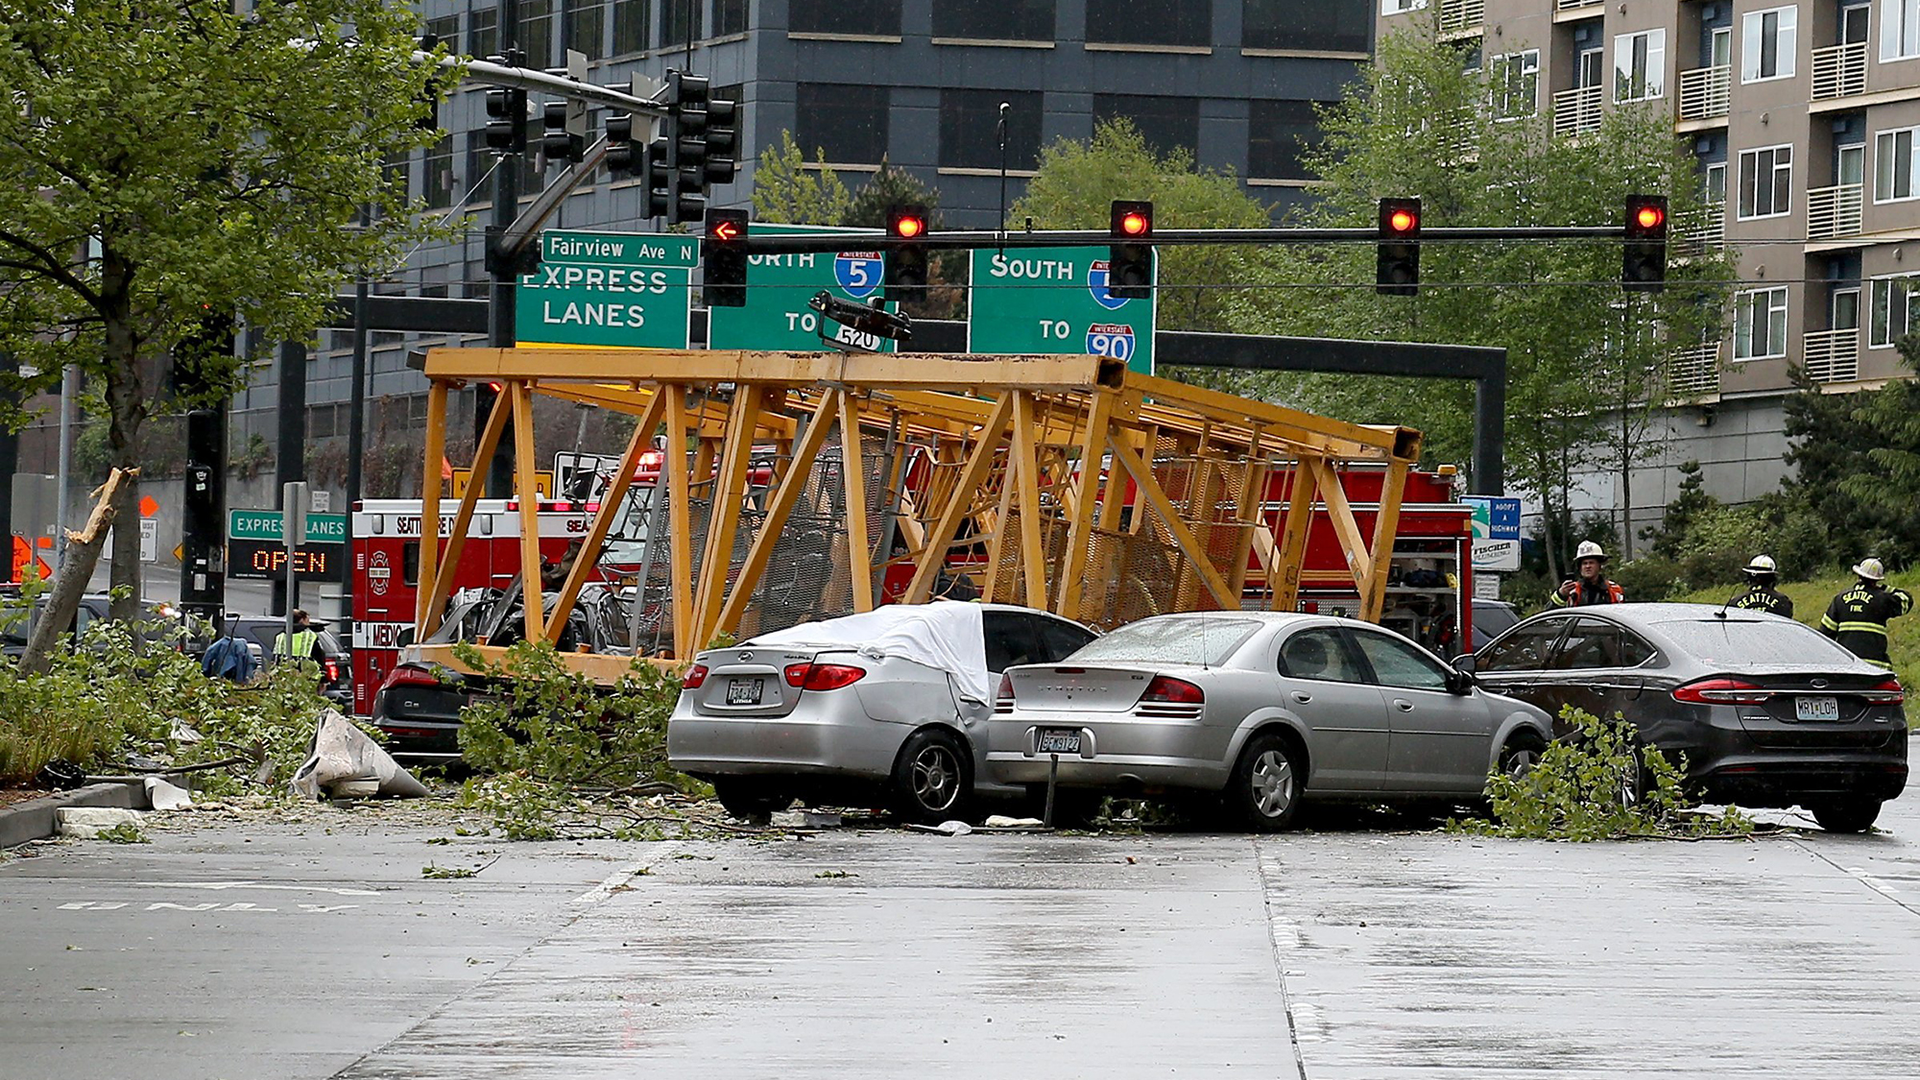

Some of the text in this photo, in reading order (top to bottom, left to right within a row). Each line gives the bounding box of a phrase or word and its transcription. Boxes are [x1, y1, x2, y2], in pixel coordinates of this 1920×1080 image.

[551, 238, 692, 260] Fairview Ave N
[747, 252, 815, 268] ORTH
[850, 261, 868, 287] 5
[544, 301, 644, 327] LANES
[785, 312, 817, 332] TO
[842, 328, 875, 348] 520
[1040, 319, 1070, 339] TO
[1092, 335, 1128, 363] 90
[237, 518, 344, 535] EXPRES LANES
[253, 550, 326, 573] OPEN
[1738, 593, 1778, 609] SEATTLE
[1842, 590, 1874, 604] SEATTLE
[1850, 604, 1863, 613] FIRE
